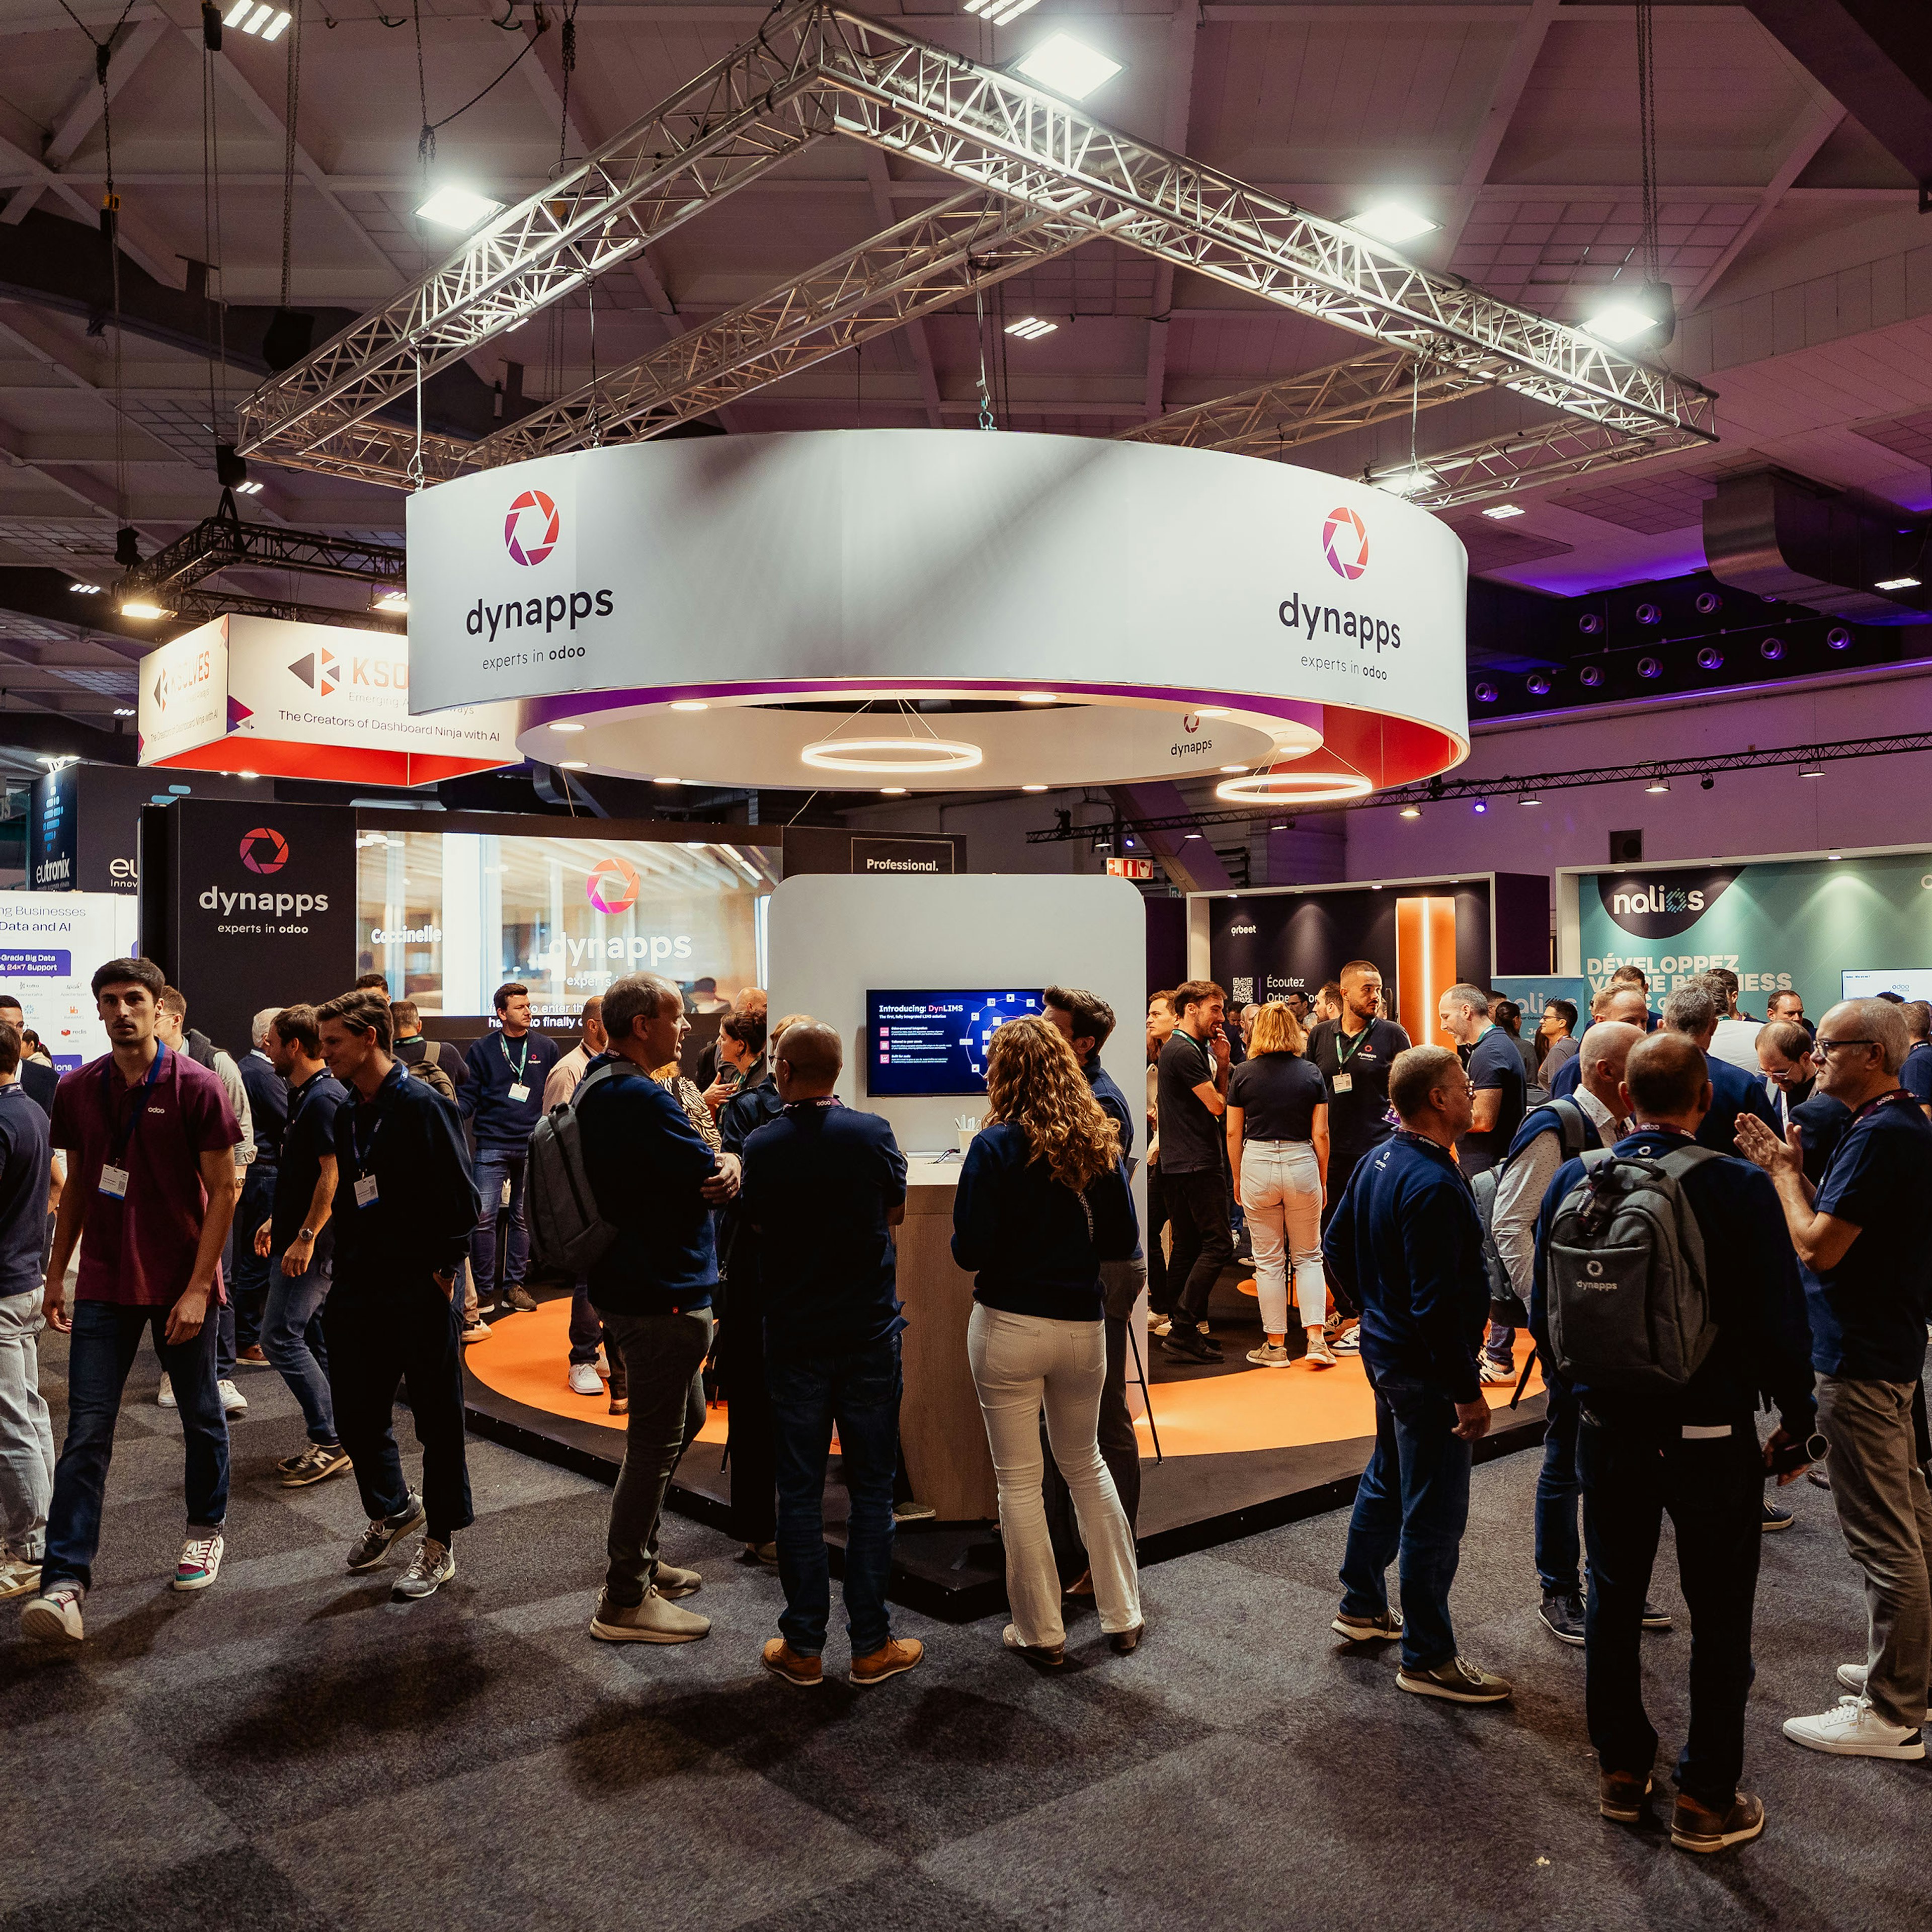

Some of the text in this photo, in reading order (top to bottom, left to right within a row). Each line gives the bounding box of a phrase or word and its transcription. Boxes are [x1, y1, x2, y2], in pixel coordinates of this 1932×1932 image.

[466, 589, 613, 642] dynapps
[1279, 593, 1401, 653] dynapps
[483, 646, 585, 671] experts in odoo
[1301, 655, 1387, 680] experts in odoo
[349, 692, 398, 707] Emerging
[279, 710, 499, 741] The Creators of Dashboard Ninja with AI
[1171, 737, 1213, 757] dynapps
[36, 851, 70, 883] eutronix
[867, 859, 938, 871] Professional.
[111, 879, 137, 888] Innov
[199, 886, 329, 917] dynapps
[1614, 885, 1704, 914] nalios
[16, 906, 86, 917] Businesses
[0, 922, 71, 931] Data and AI
[218, 924, 308, 934] experts in odoo
[1231, 925, 1256, 936] orbeet
[371, 925, 442, 944] Coccinelle
[549, 932, 692, 967] dynapps
[26, 954, 37, 963] Big
[1587, 952, 1739, 975] DÉVELOPPEZ
[27, 964, 57, 972] Support
[1266, 974, 1305, 988] Écoutez
[1267, 993, 1290, 1003] Orbe
[541, 1005, 571, 1013] enter
[879, 1004, 963, 1014] Introducing: DynLIMS
[543, 1016, 575, 1029] finally
[1877, 1095, 1895, 1105] odoo
[1576, 1280, 1618, 1292] dynapps
